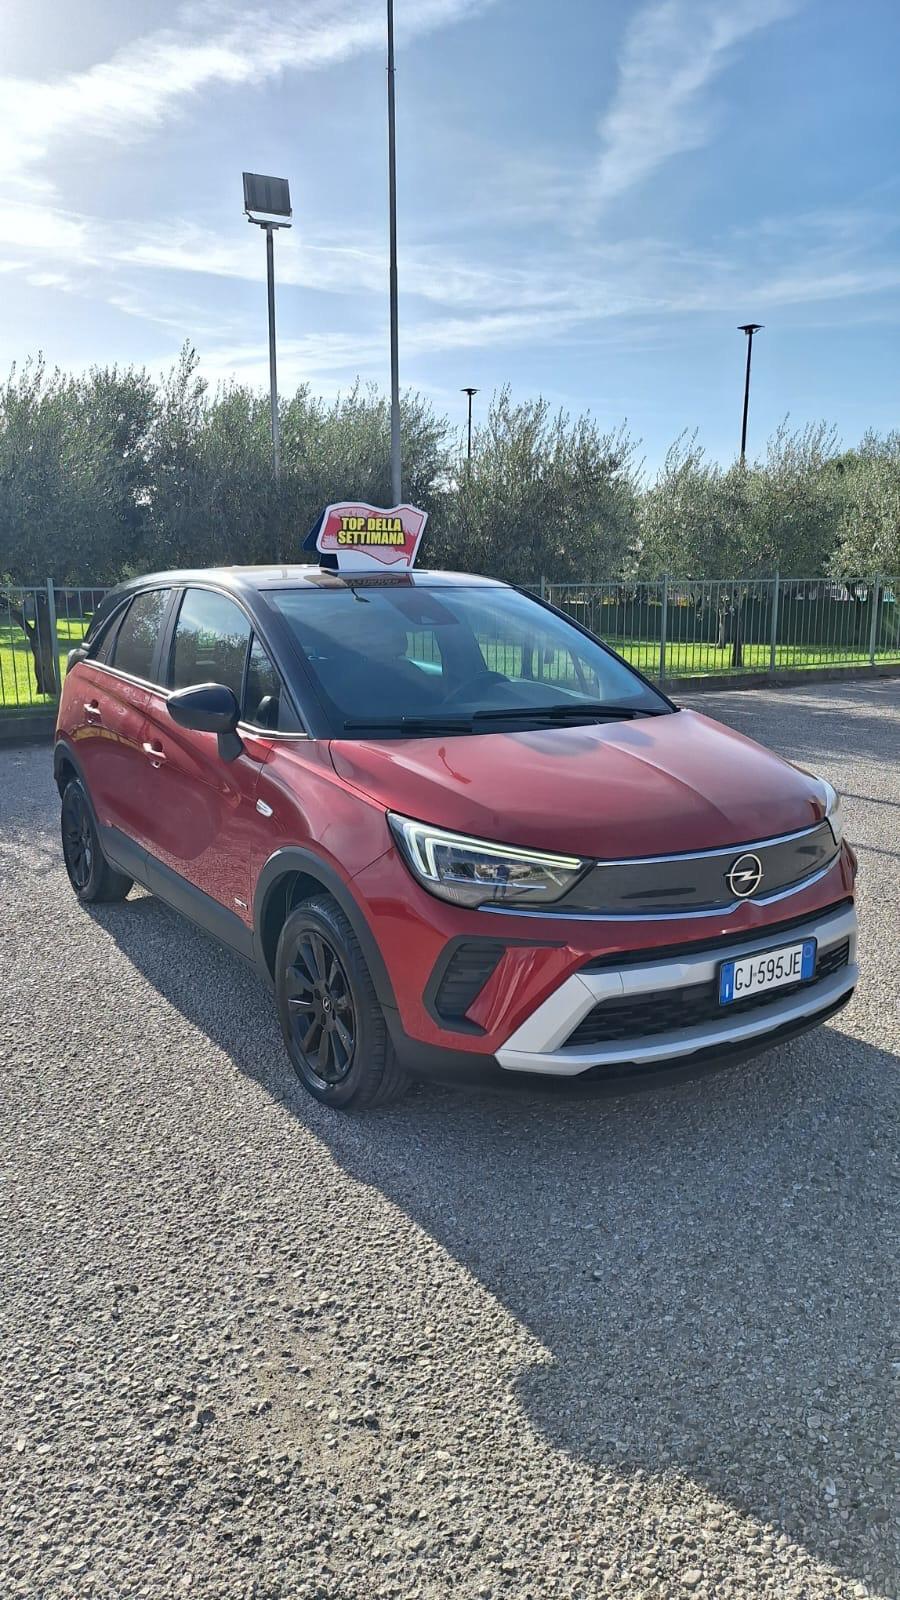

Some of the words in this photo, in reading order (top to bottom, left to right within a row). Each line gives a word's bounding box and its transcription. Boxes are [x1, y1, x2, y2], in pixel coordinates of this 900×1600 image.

[341, 517, 364, 531] TOP
[367, 518, 401, 531] DELLA
[338, 531, 405, 545] SETTIMANA
